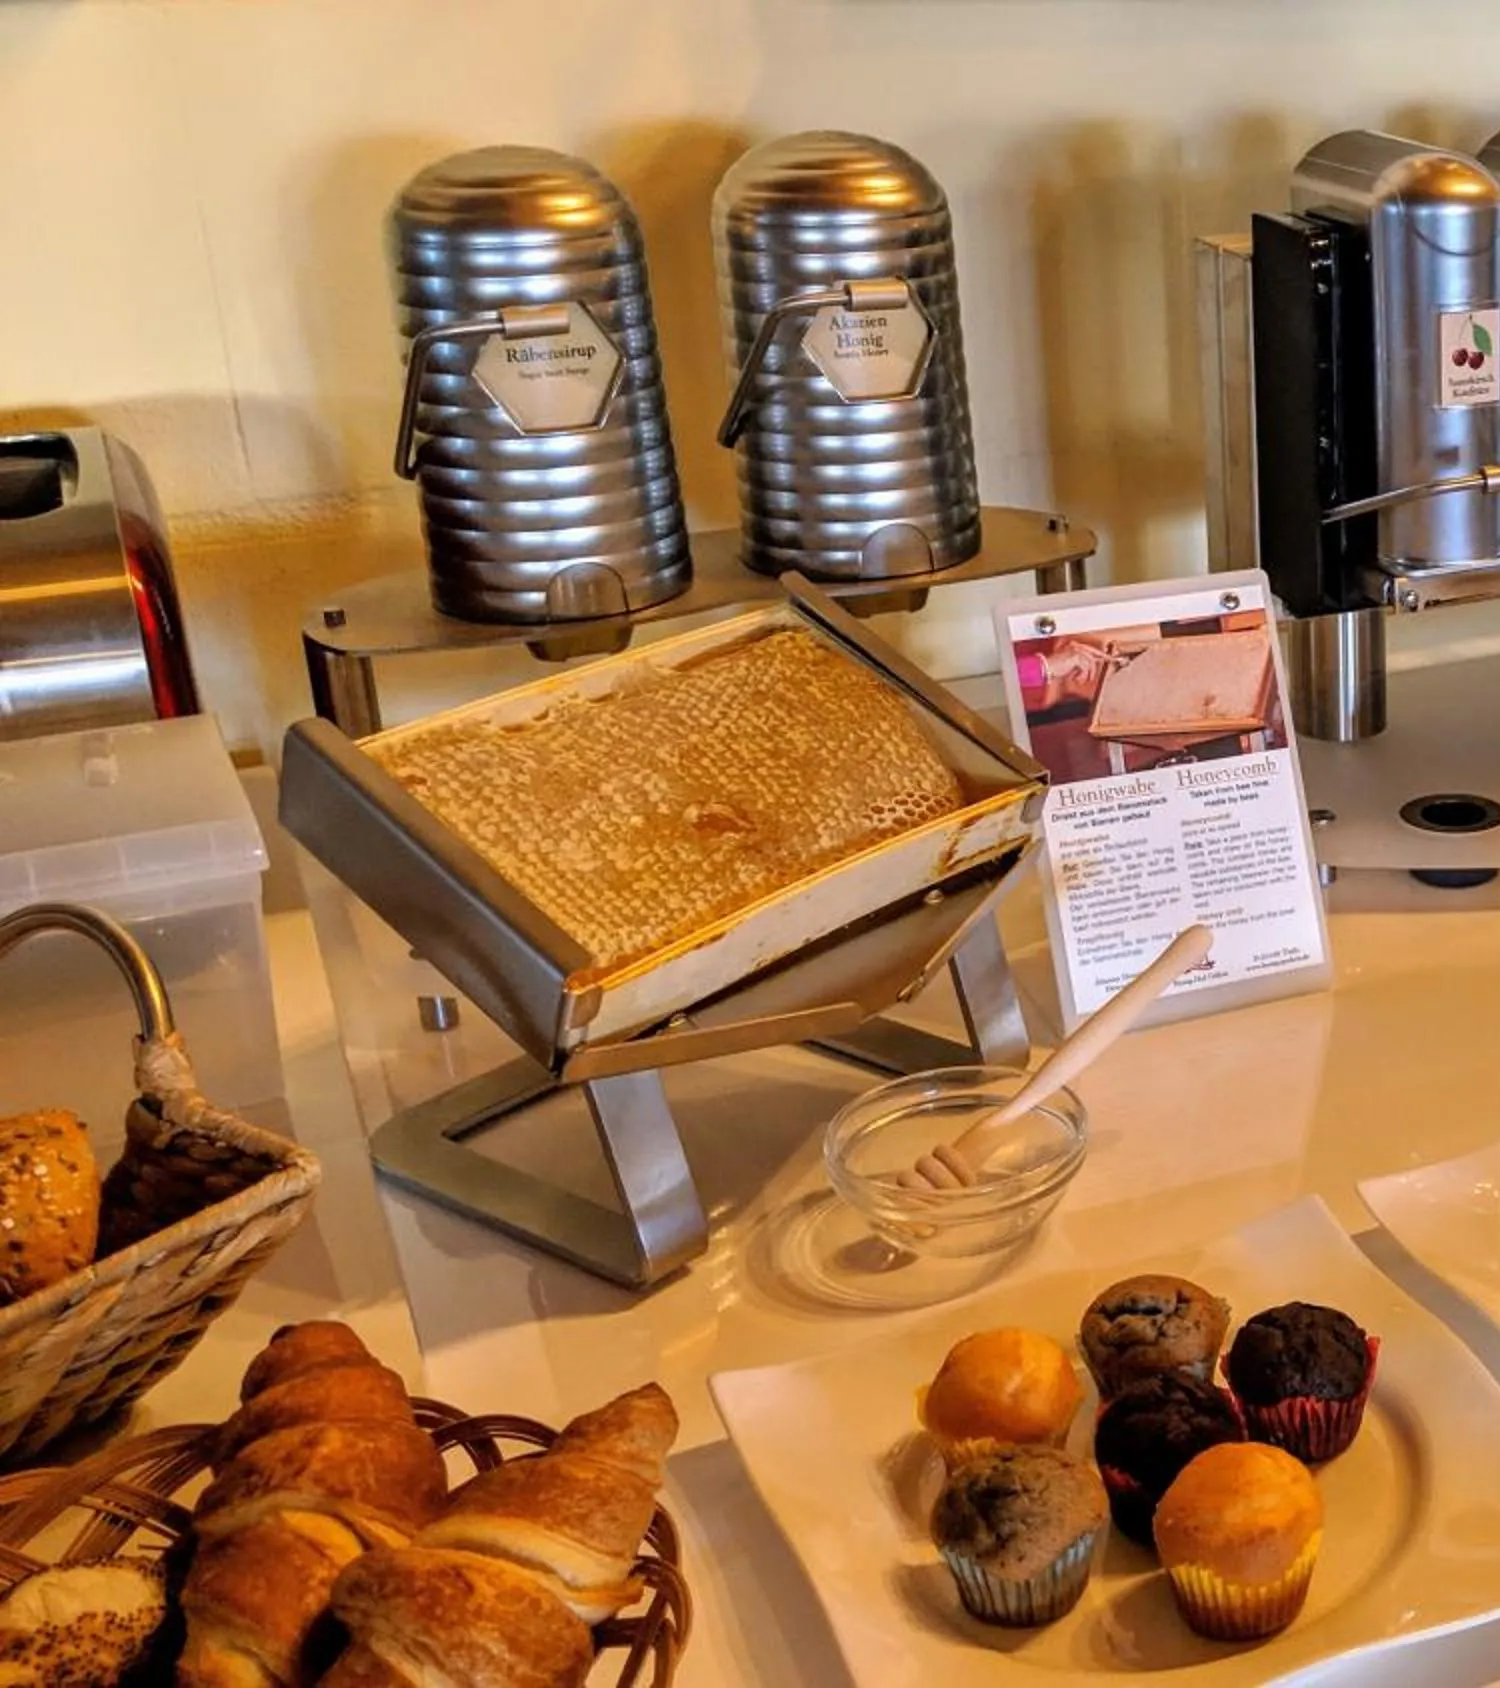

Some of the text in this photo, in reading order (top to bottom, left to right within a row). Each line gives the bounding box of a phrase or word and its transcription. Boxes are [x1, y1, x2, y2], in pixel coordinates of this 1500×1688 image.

[837, 331, 883, 349] Honig
[1177, 756, 1277, 787] Honeycomb
[1059, 778, 1157, 807] Honigwabe
